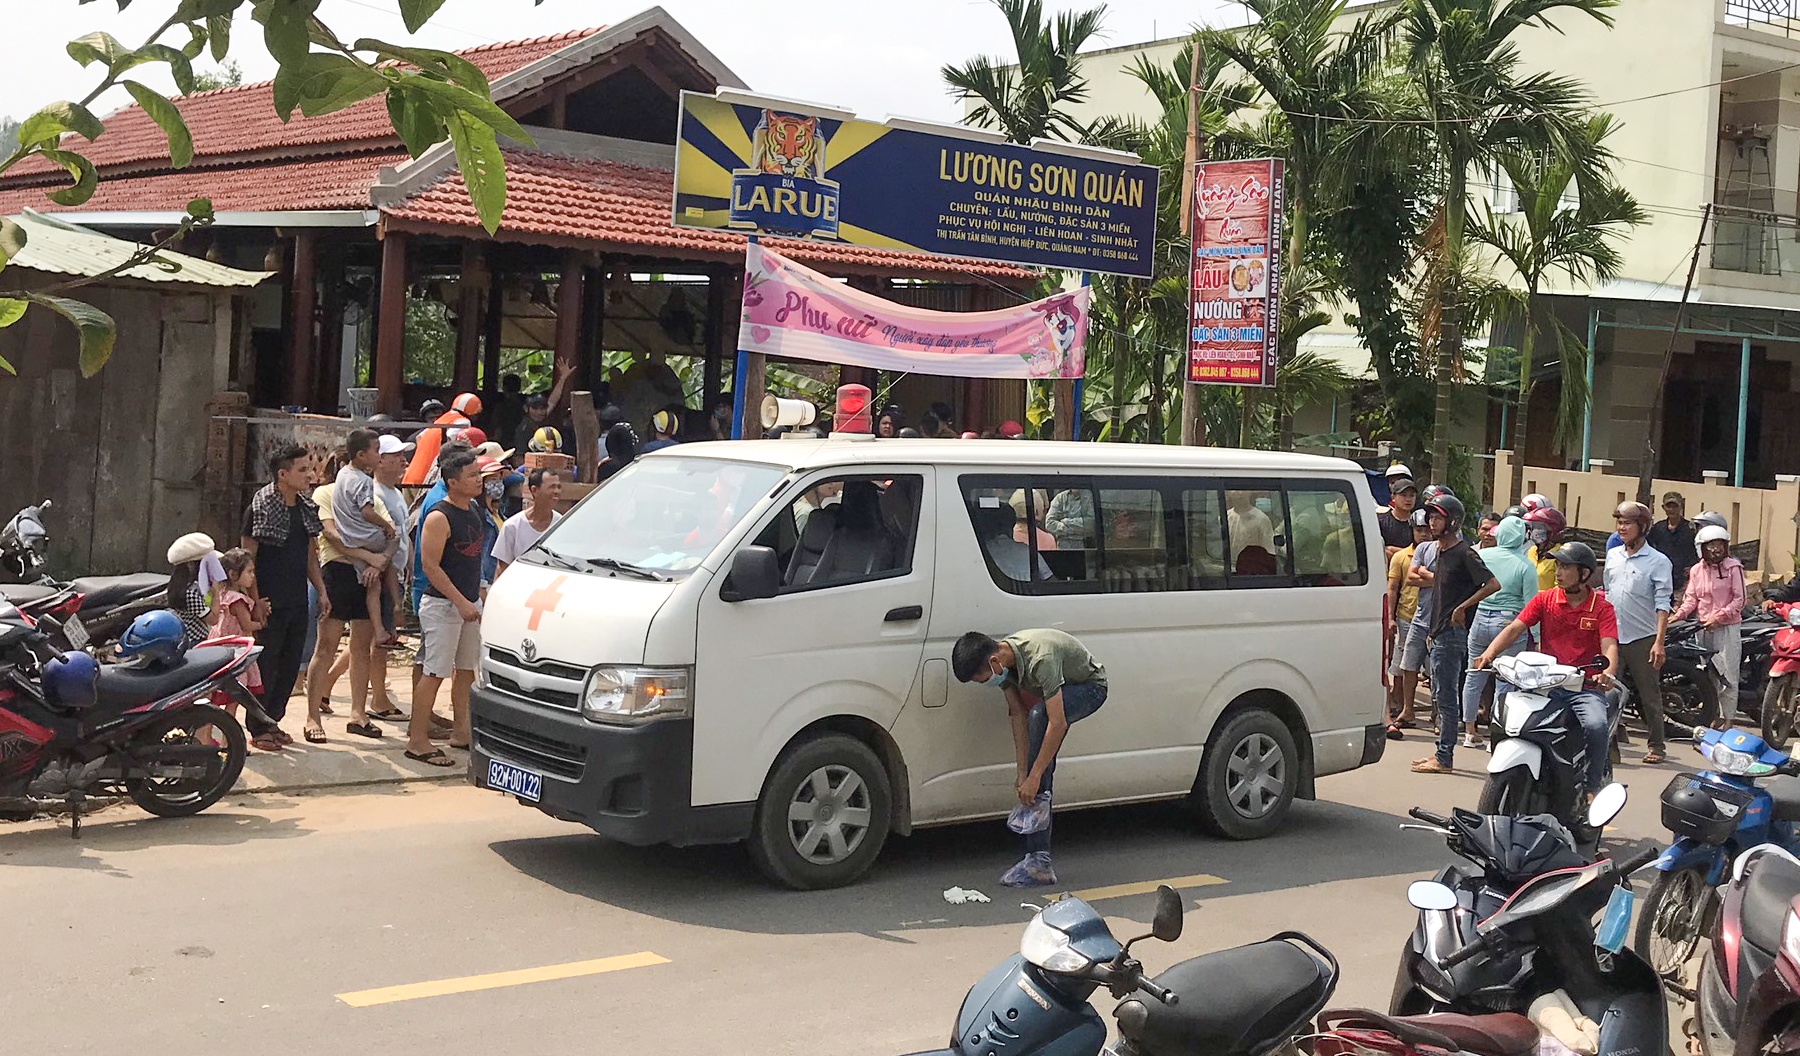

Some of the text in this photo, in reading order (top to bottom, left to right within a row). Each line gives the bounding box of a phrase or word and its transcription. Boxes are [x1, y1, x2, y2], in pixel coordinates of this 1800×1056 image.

[782, 178, 795, 188] BIA
[940, 149, 1143, 208] LƯƠNG SƠN QUÁN
[734, 184, 837, 221] LARUE
[949, 202, 992, 216] CHUYÊN:
[1059, 215, 1078, 228] ĐẶC
[1080, 217, 1099, 230] SẢN
[1100, 222, 1106, 231] 3
[1014, 196, 1049, 210] NHẬU
[1052, 201, 1082, 214] BÌNH
[1085, 206, 1110, 218] DÂN
[936, 228, 948, 240] THỊ
[1072, 246, 1087, 255] NAM
[939, 214, 966, 227] PHỤC
[969, 218, 981, 229] VỤ
[984, 219, 1001, 232] HỘI
[1003, 222, 1026, 236] NGHỊ
[1035, 226, 1055, 238] LIÊN
[1057, 229, 1083, 241] HOAN
[1091, 234, 1113, 245] SINH
[1114, 237, 1139, 249] NHẬT
[776, 291, 831, 334] Phụ
[837, 314, 878, 338] nữ
[1194, 297, 1243, 320] NƯỚNG
[1193, 325, 1210, 344] ĐẶC
[1212, 323, 1229, 341] SẢN
[1231, 328, 1238, 341] 3
